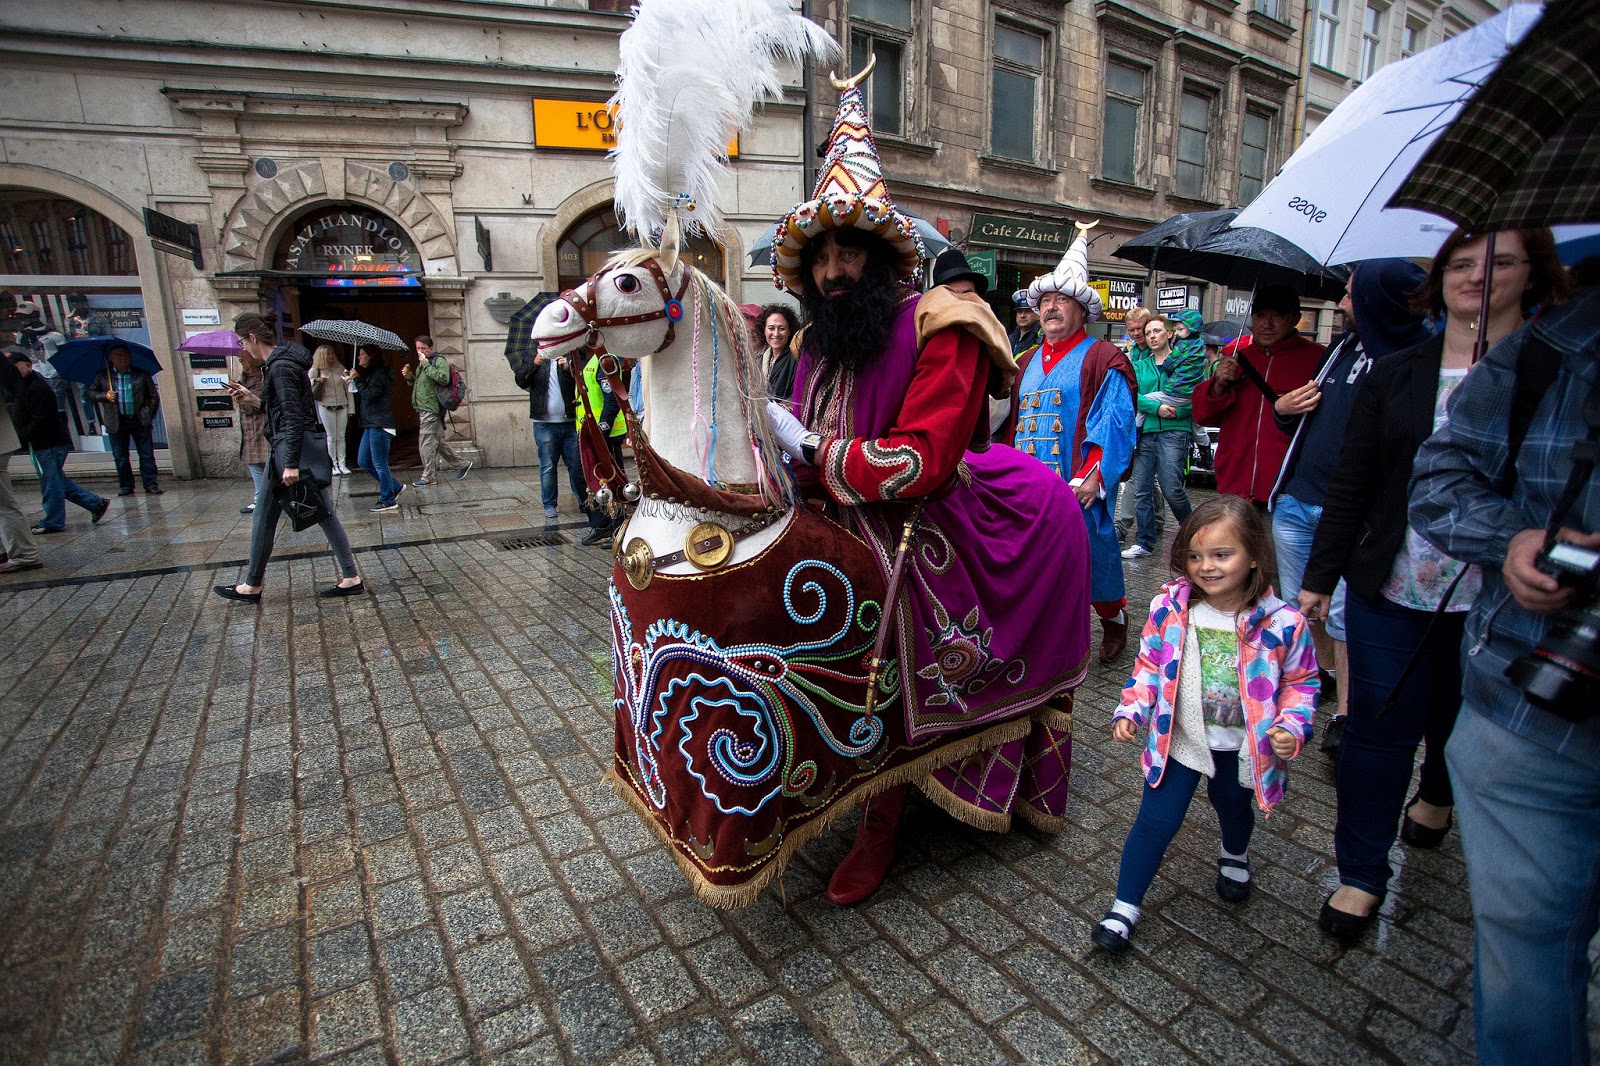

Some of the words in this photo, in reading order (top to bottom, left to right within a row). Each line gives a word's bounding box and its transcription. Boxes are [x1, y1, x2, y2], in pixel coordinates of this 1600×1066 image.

[576, 109, 614, 130] L'O
[982, 222, 1012, 237] Café
[1016, 226, 1061, 243] Zakątek
[322, 245, 376, 256] RYNEK
[1159, 288, 1185, 298] KANTOR
[110, 310, 130, 319] year
[111, 319, 139, 328] denim
